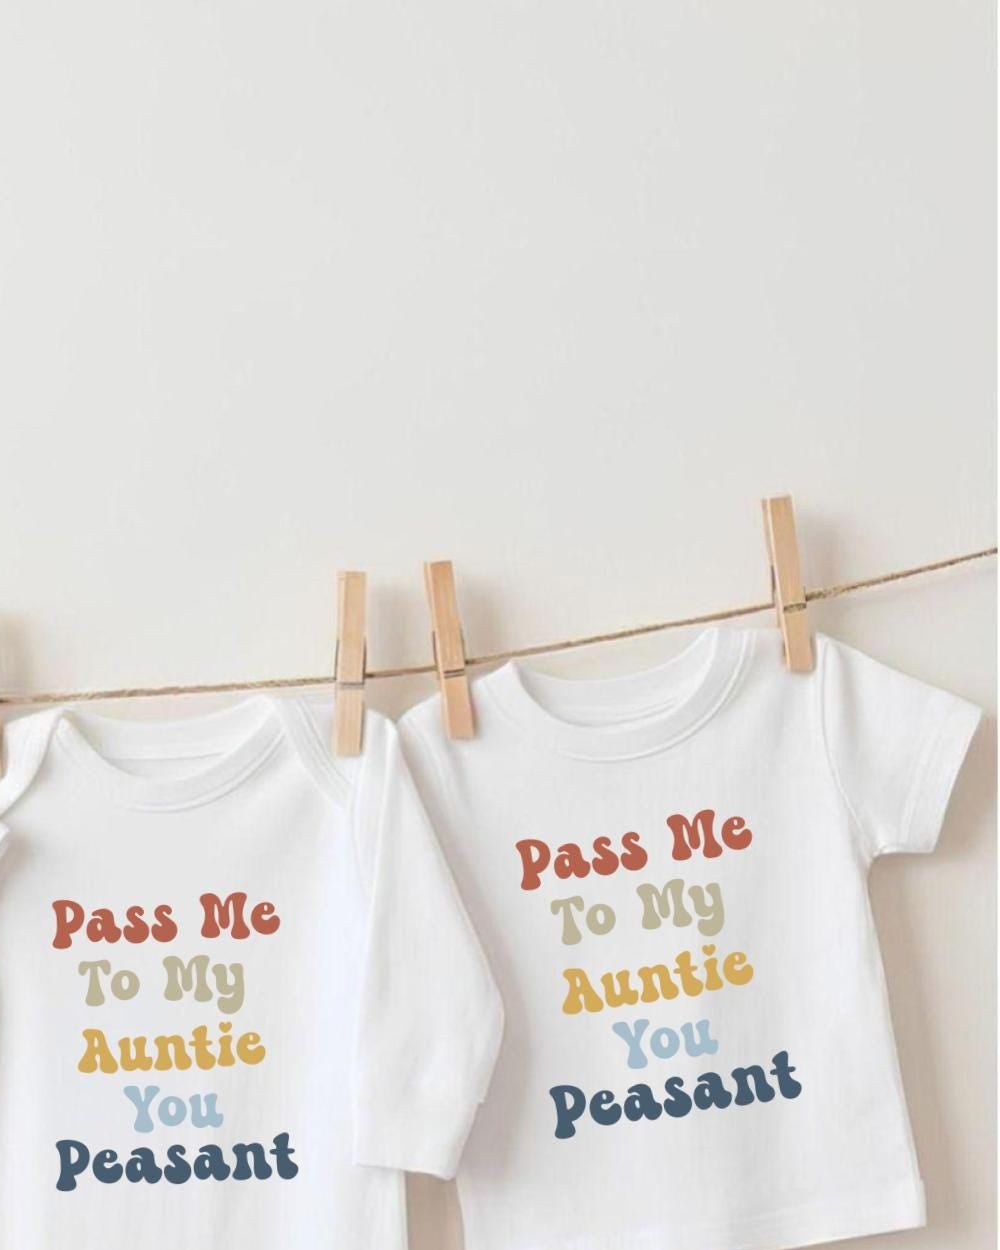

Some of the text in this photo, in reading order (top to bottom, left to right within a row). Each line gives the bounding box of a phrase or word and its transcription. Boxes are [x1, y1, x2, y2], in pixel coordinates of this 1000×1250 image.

[514, 808, 754, 892] Pass Me
[50, 890, 282, 951] Pass Me
[550, 878, 725, 946] To My
[78, 954, 245, 1015] To My
[560, 943, 755, 1017] Auntie
[76, 1020, 267, 1075] Auntie
[611, 1018, 719, 1070] You
[123, 1085, 224, 1134] You
[548, 1049, 803, 1140] Peasant
[54, 1131, 300, 1193] Peasant
